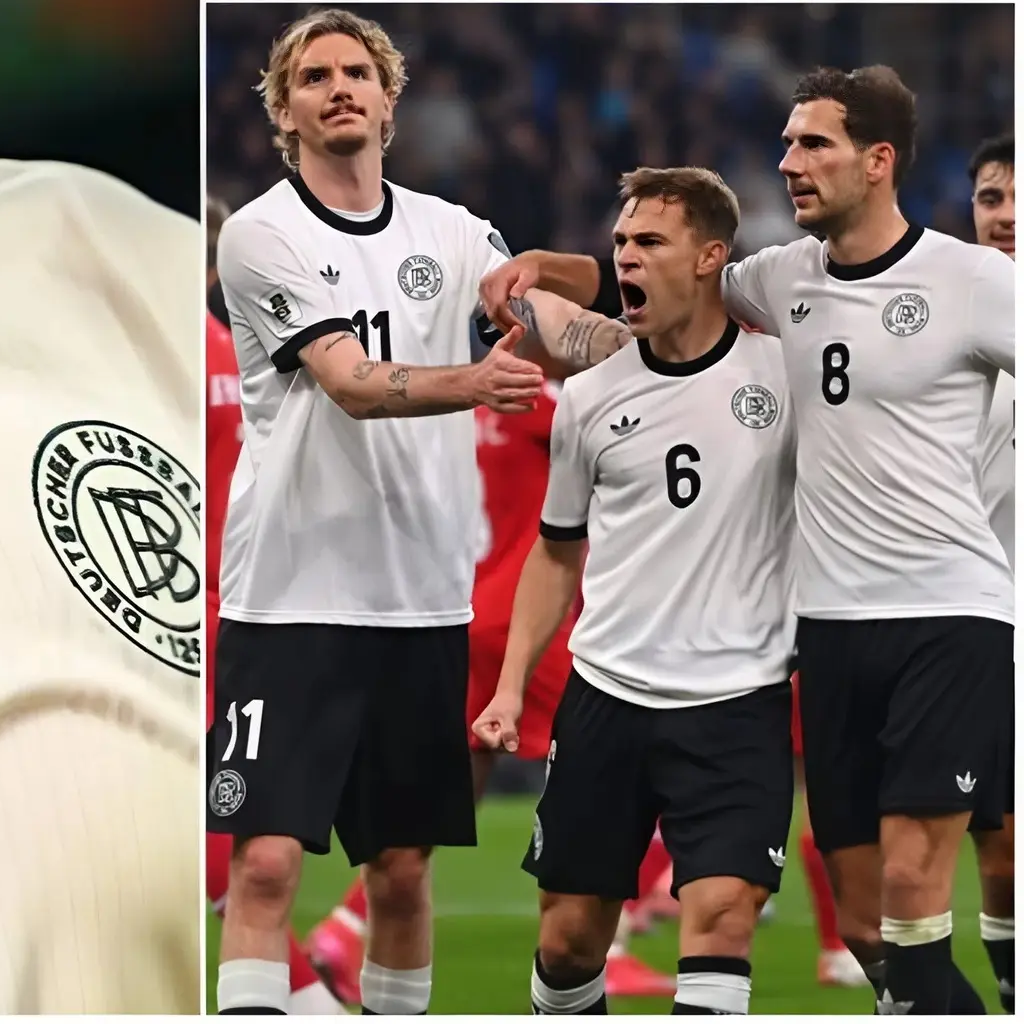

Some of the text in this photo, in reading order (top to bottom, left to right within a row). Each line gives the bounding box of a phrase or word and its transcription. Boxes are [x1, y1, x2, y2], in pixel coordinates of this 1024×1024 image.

[351, 309, 392, 362] 11
[821, 342, 849, 405] 8
[665, 443, 701, 508] 6
[221, 699, 264, 761] 11
